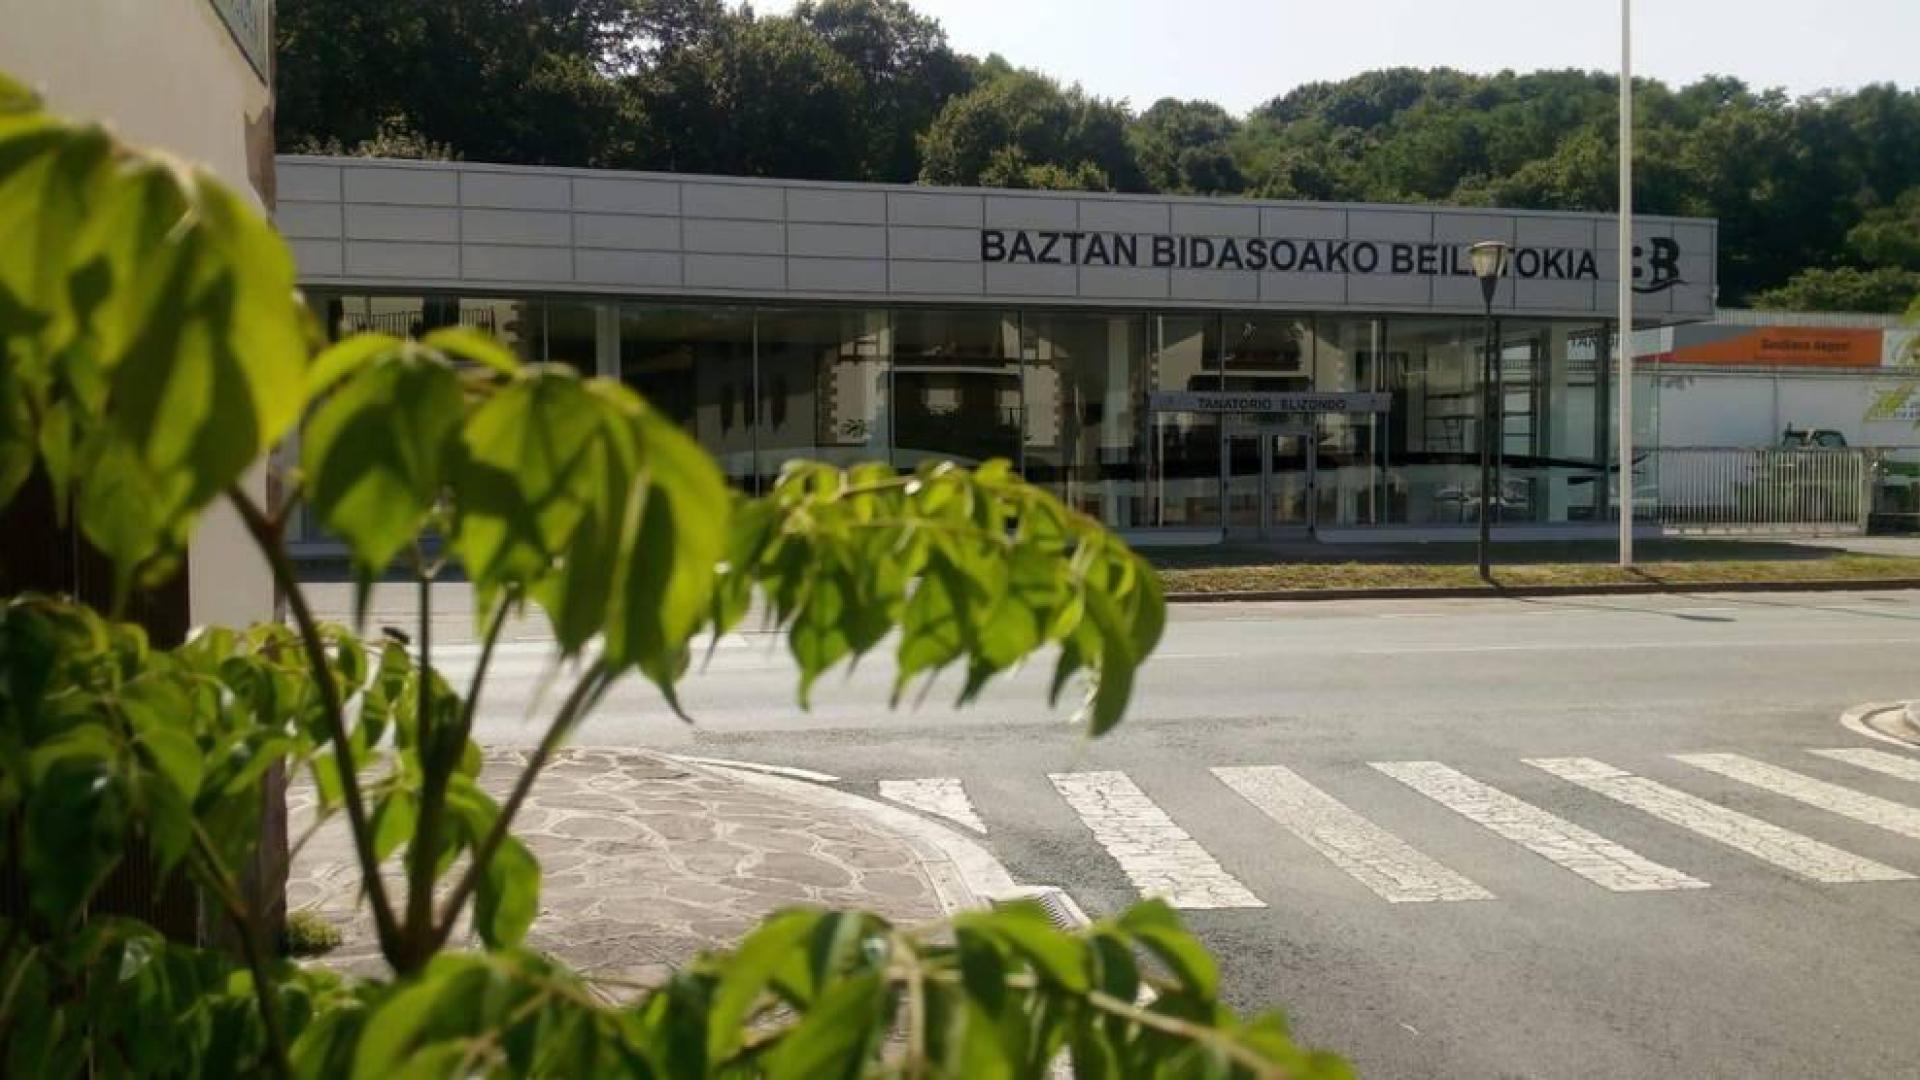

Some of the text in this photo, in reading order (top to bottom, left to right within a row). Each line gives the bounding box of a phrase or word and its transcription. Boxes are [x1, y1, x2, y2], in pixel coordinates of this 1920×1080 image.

[981, 229, 1599, 280] BAZTAN BIDASOAKO BEILTOKIA
[1198, 398, 1347, 410] TANATORIO ELIZONDO
